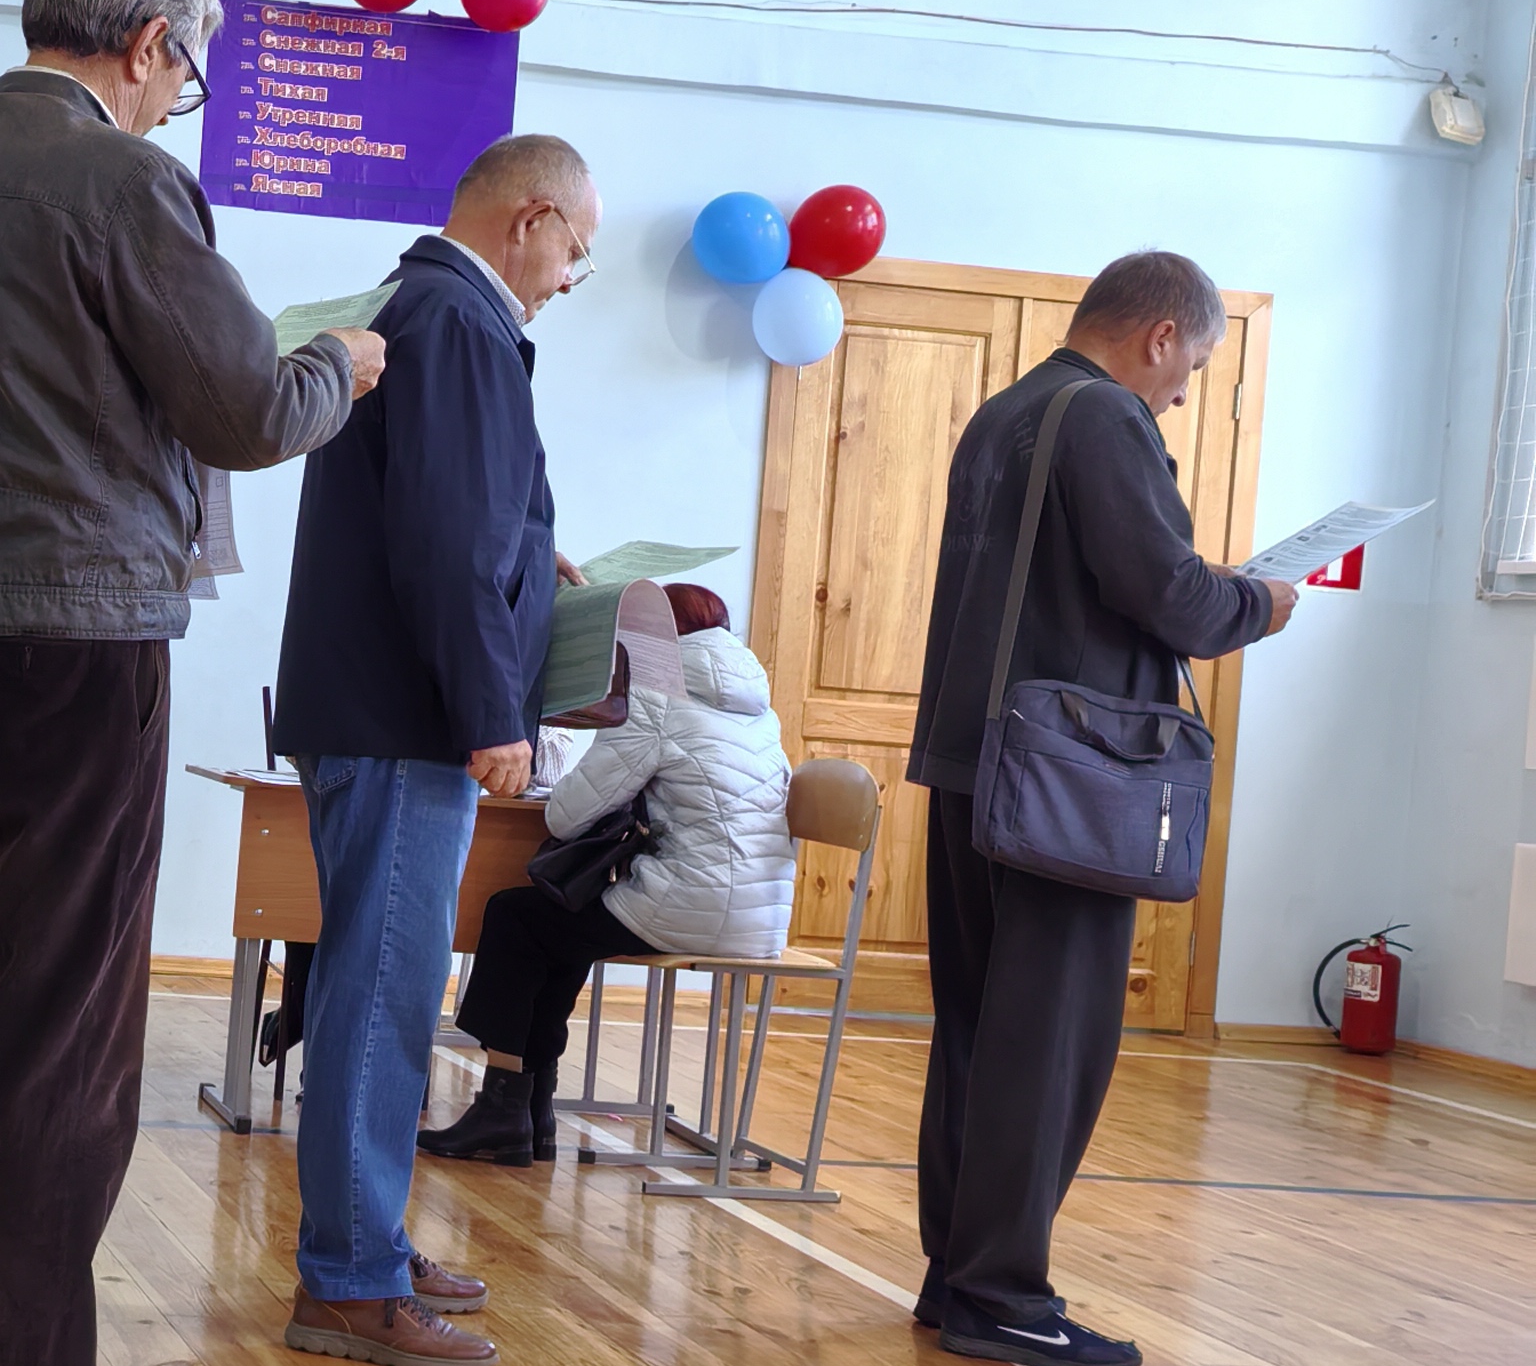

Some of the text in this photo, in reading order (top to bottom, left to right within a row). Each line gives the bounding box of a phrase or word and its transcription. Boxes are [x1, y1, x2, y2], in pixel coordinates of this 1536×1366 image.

[260, 4, 393, 36] Сапфирная
[259, 29, 363, 57] Снежная
[371, 39, 406, 61] 2-я
[257, 52, 362, 80] Снежная
[257, 76, 328, 102] Тихая
[255, 101, 362, 130] Утренняя
[252, 125, 406, 160] Хлеборобная
[251, 149, 331, 174] Юрина
[250, 173, 323, 198] Ясная
